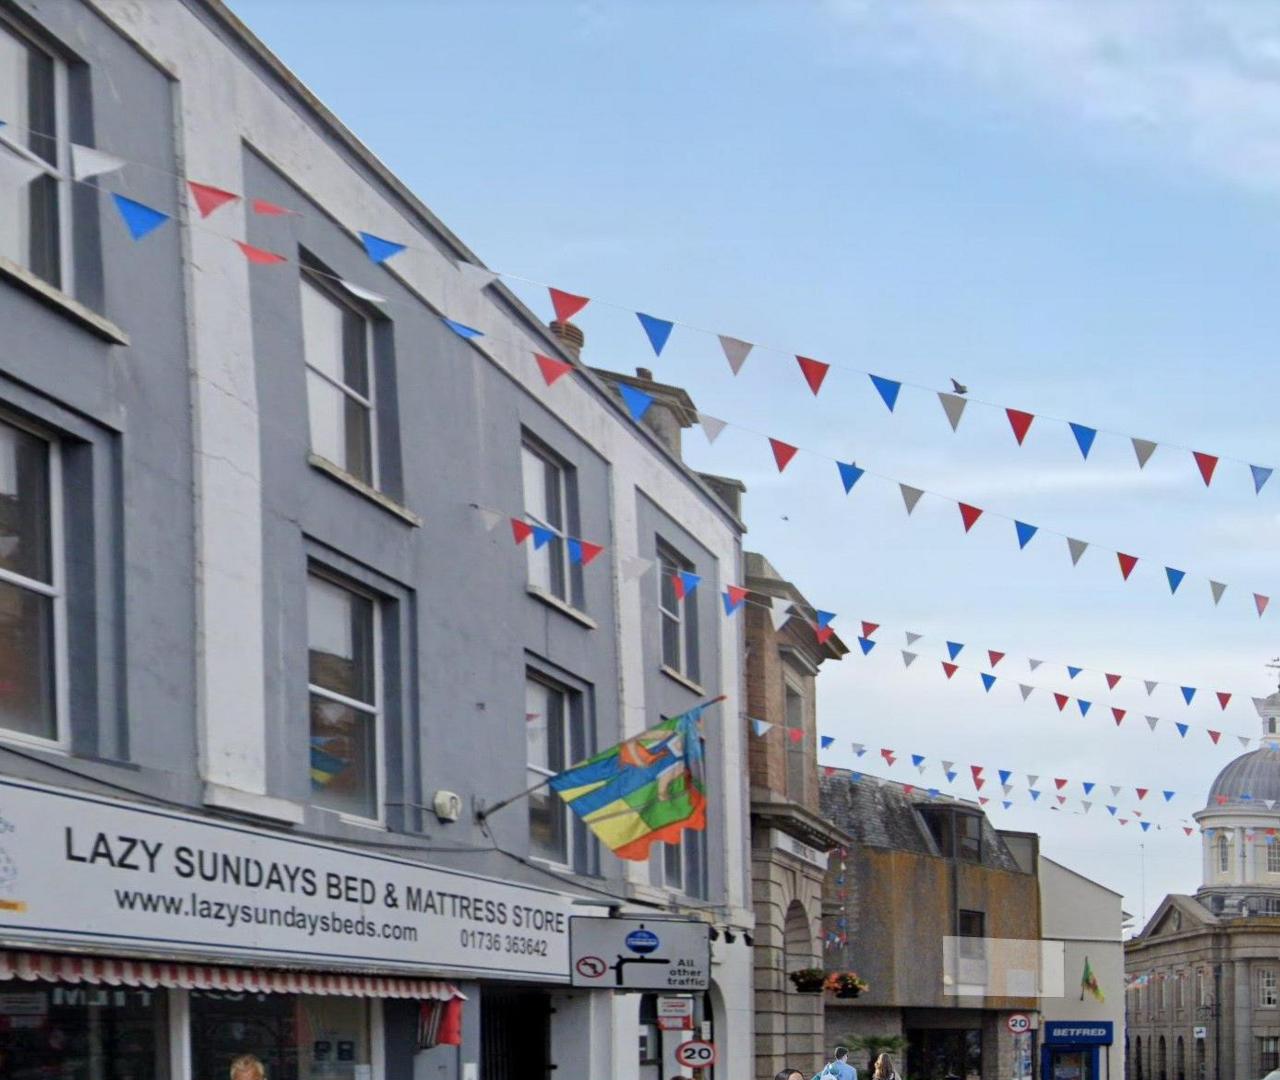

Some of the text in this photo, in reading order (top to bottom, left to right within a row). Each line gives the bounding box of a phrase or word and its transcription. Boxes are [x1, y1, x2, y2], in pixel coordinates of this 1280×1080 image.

[65, 827, 565, 933] LAZY SUNDAYS BED & MATTRESS STORE
[114, 889, 418, 942] www.lazysundaysbeds.com
[460, 929, 548, 957] 01736 363642
[677, 959, 694, 967] All
[669, 969, 702, 977] other
[667, 978, 706, 986] traffic
[1010, 1018, 1026, 1028] 20
[1053, 1028, 1106, 1037] BETFRED
[683, 1048, 711, 1060] 20
